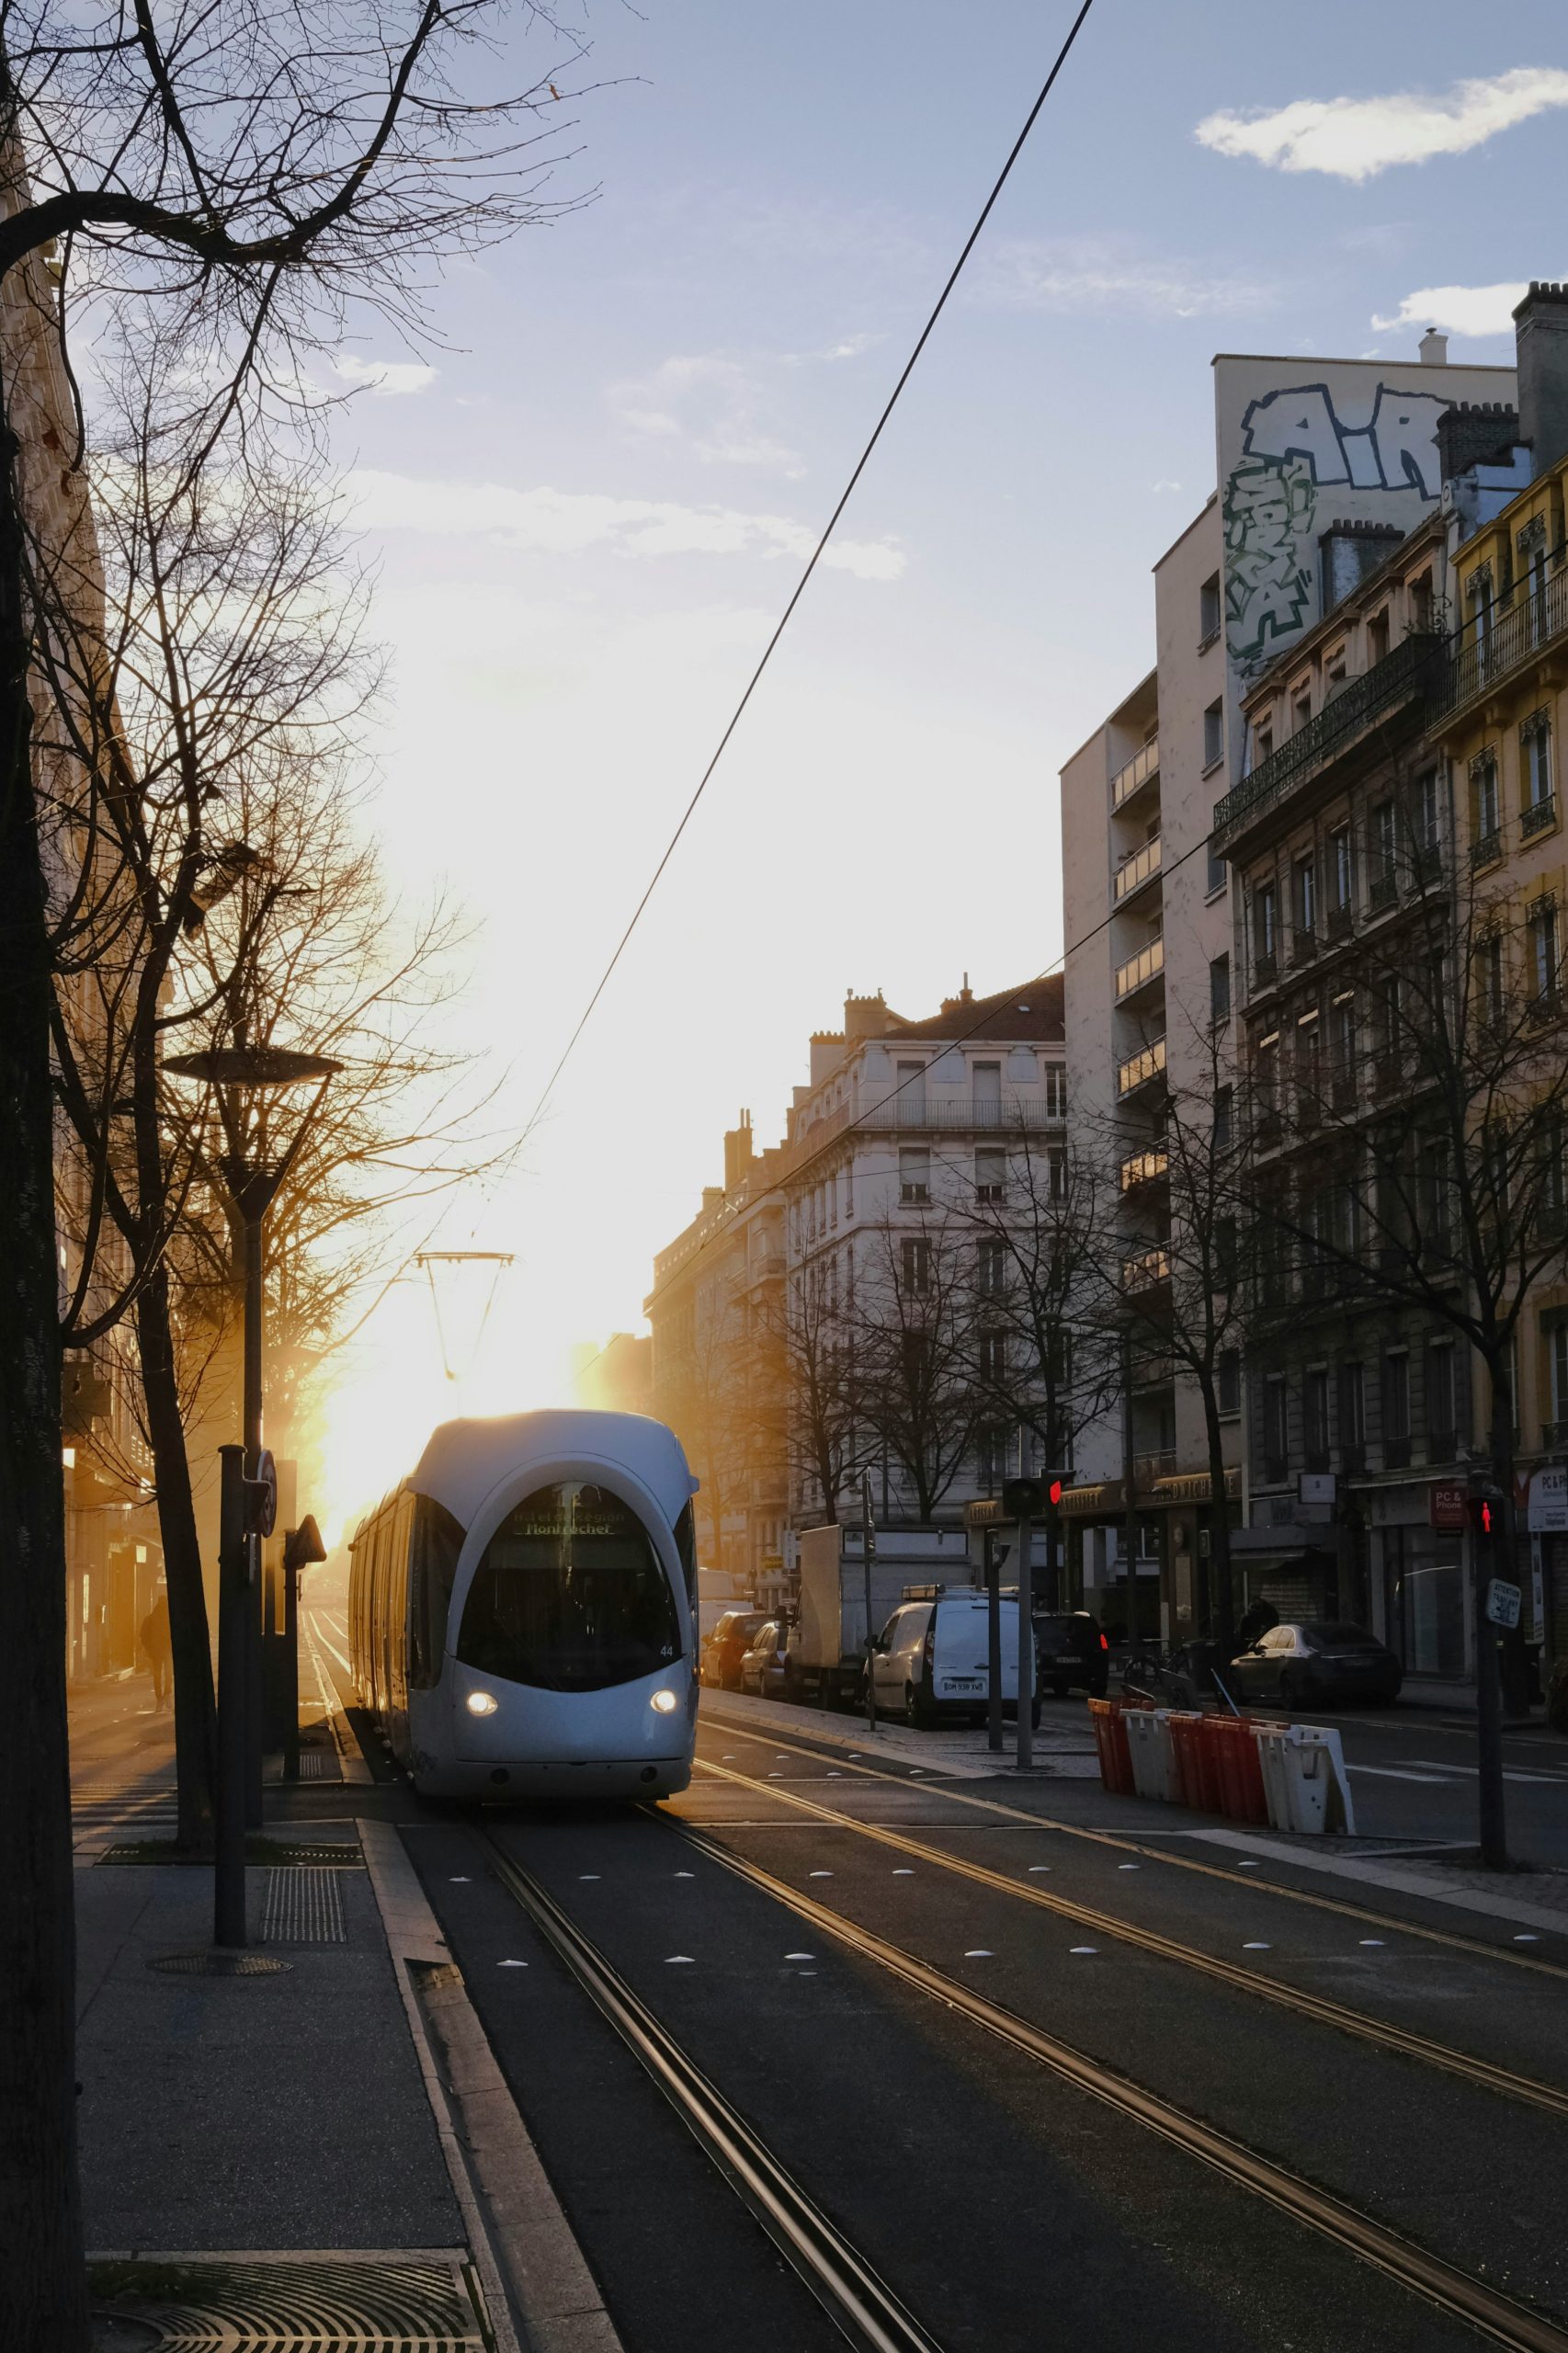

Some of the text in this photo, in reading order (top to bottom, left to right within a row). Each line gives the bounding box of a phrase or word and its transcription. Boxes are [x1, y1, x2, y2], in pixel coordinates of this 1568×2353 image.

[1436, 1492, 1461, 1502] PC &
[1436, 1501, 1461, 1509] Phone
[660, 1645, 673, 1657] 44
